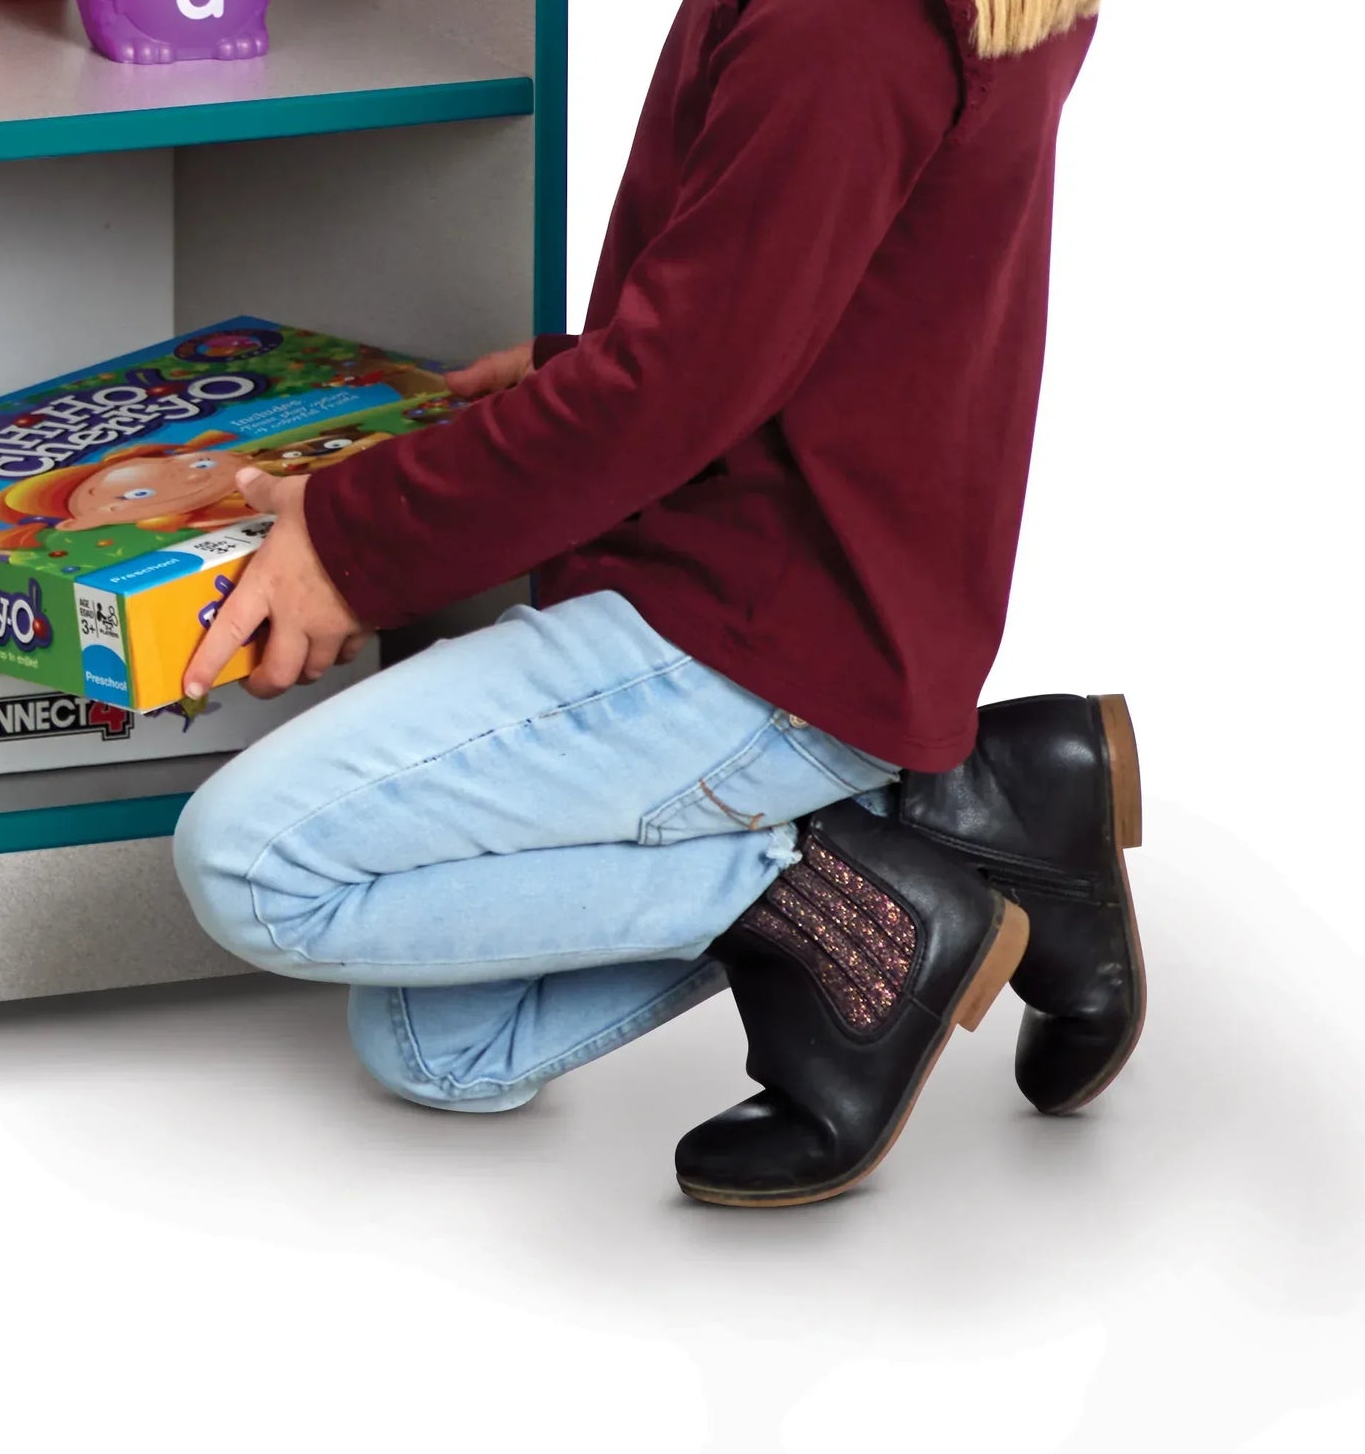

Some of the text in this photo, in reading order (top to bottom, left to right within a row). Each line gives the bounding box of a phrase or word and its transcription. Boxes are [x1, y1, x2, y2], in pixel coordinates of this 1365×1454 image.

[110, 558, 180, 583] Preschool
[81, 619, 96, 634] 3+
[85, 670, 127, 691] Preschool
